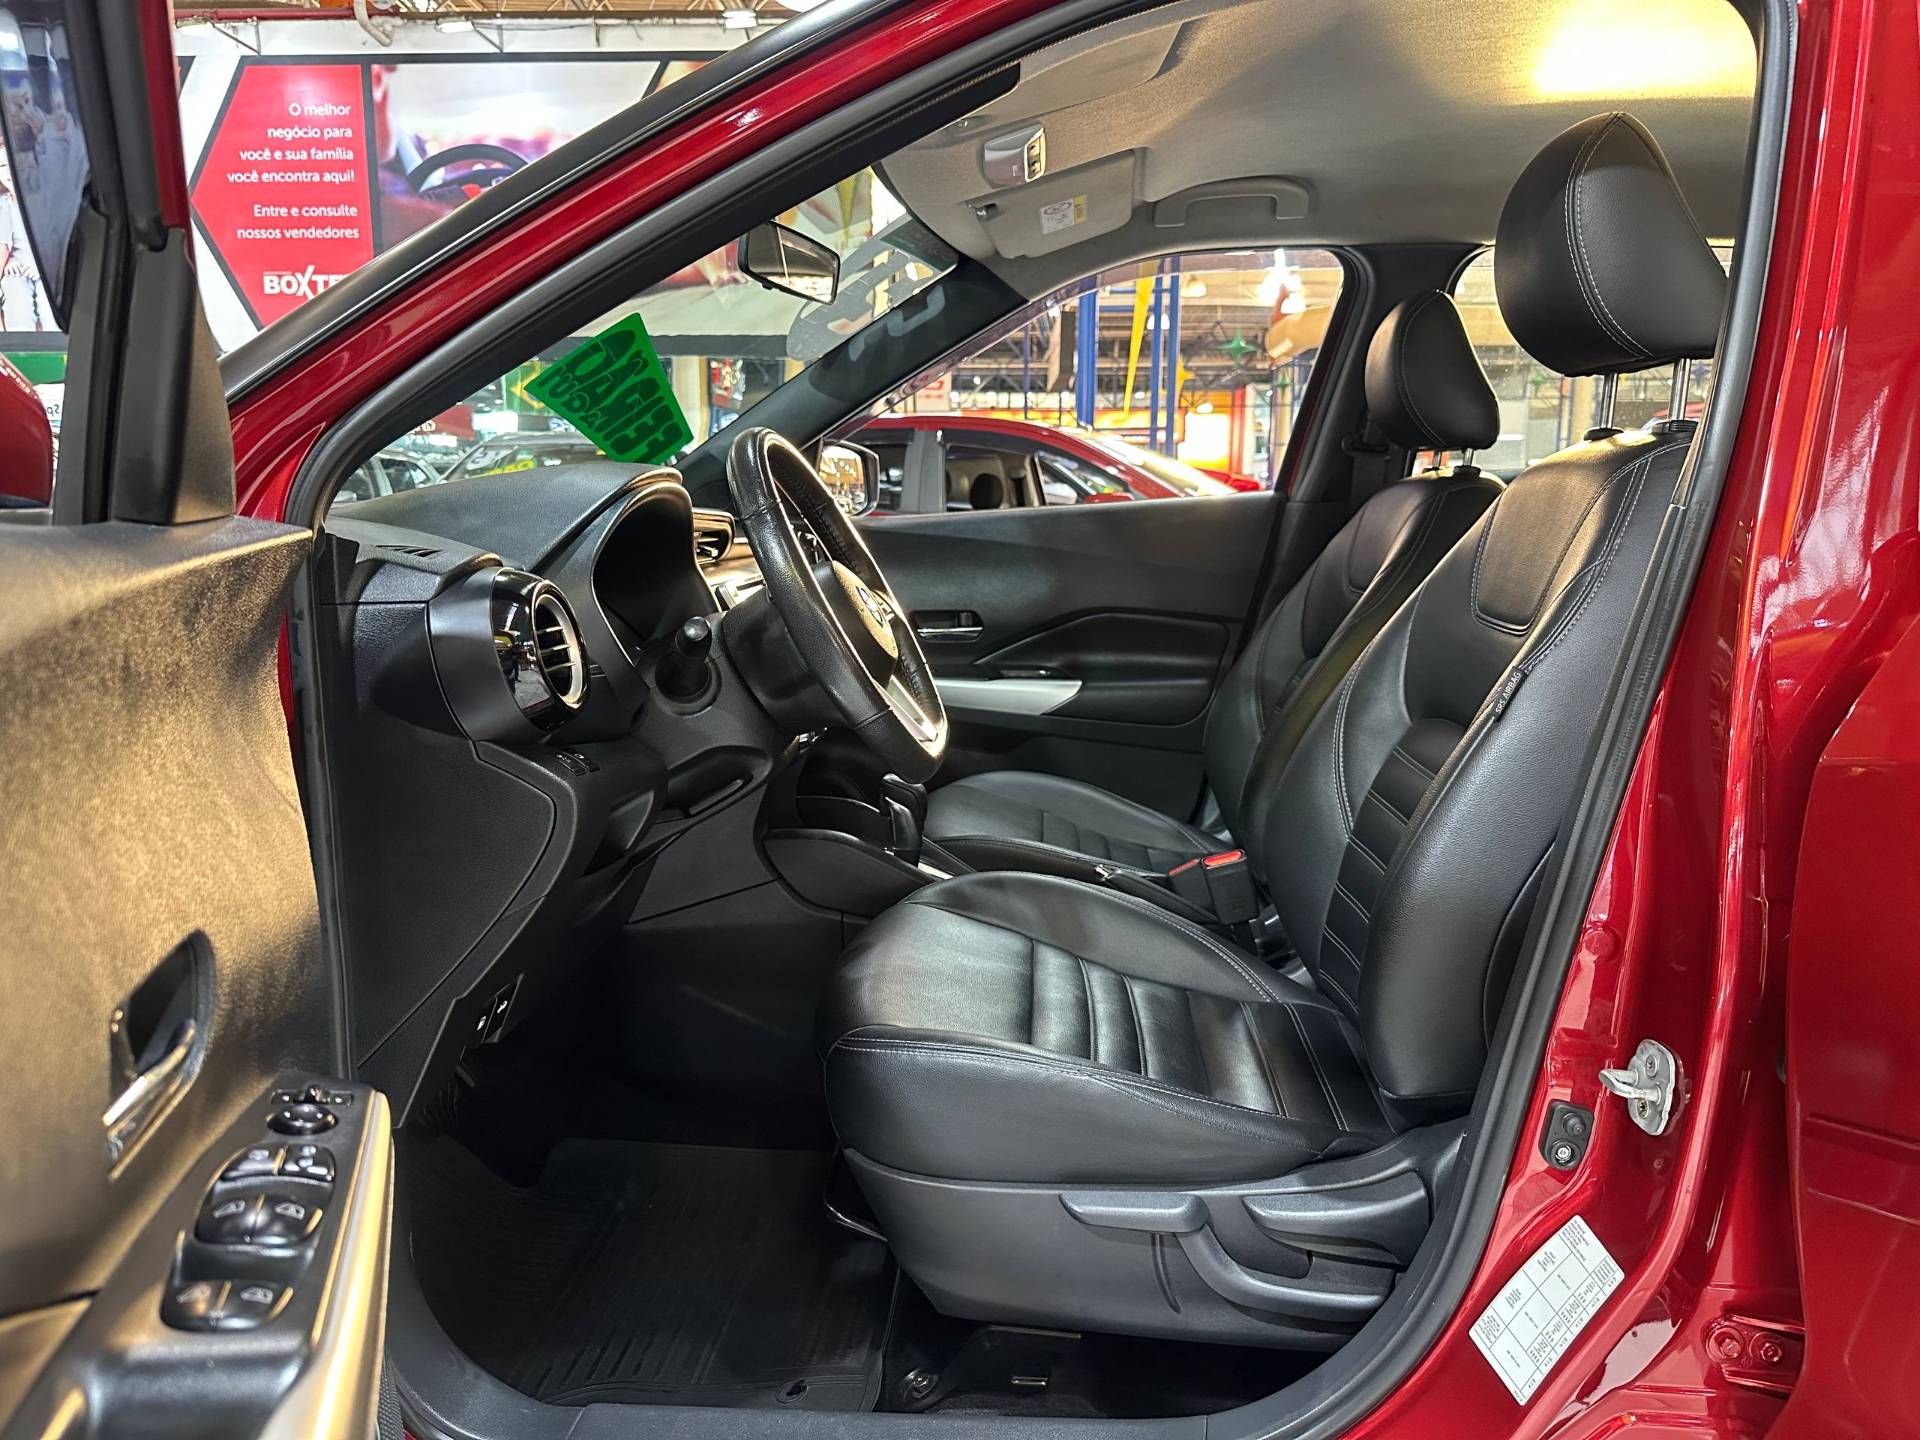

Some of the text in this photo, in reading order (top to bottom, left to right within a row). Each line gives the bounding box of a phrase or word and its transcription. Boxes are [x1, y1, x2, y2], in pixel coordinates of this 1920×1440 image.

[289, 103, 351, 116] O melhor
[267, 126, 352, 140] negócio para
[240, 147, 354, 160] você e sua família
[227, 169, 355, 184] você encontra aqui!
[253, 204, 358, 217] Entre e consulte
[236, 226, 359, 239] nossos vendedores
[1495, 671, 1521, 713] SRS AIRBAG
